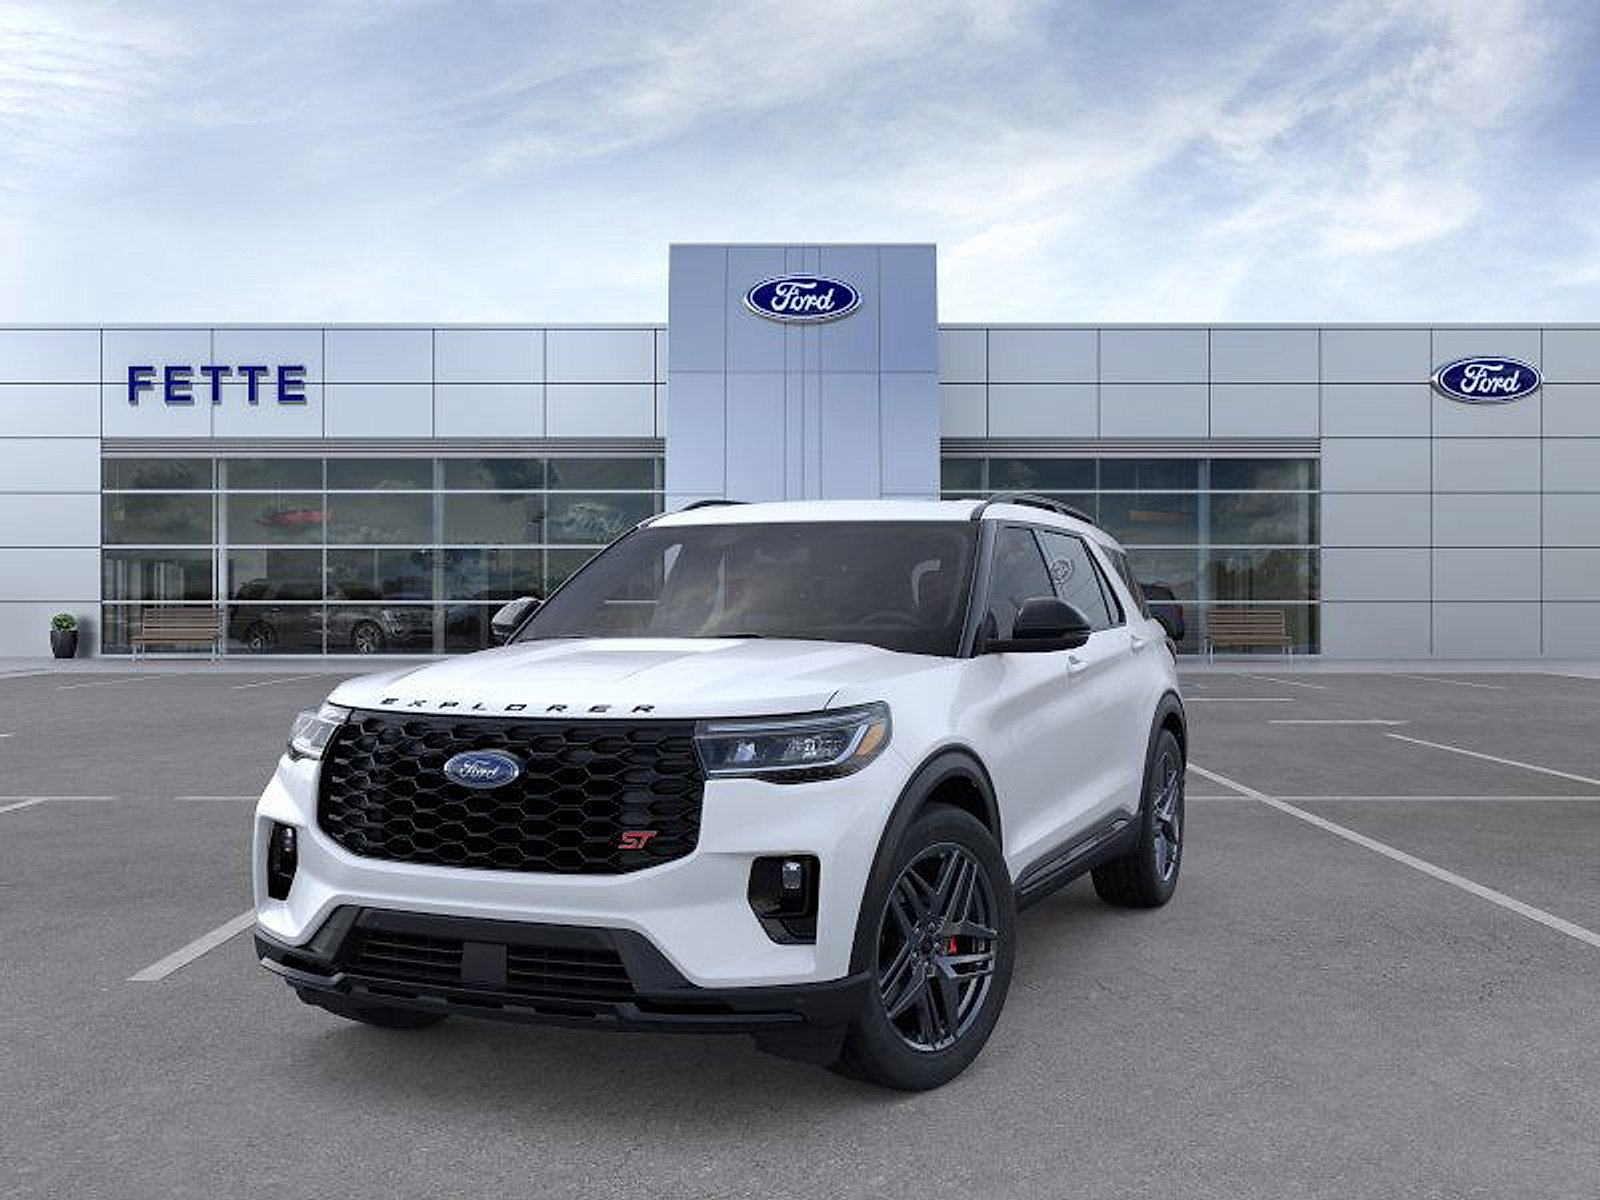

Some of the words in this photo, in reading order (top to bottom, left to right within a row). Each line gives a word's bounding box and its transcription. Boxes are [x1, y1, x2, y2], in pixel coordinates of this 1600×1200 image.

[770, 281, 836, 312] Ford
[127, 365, 306, 404] FETTE
[1460, 363, 1522, 393] Ford
[379, 697, 656, 714] EXPLORER
[460, 759, 500, 779] Ford
[617, 830, 659, 850] ST
